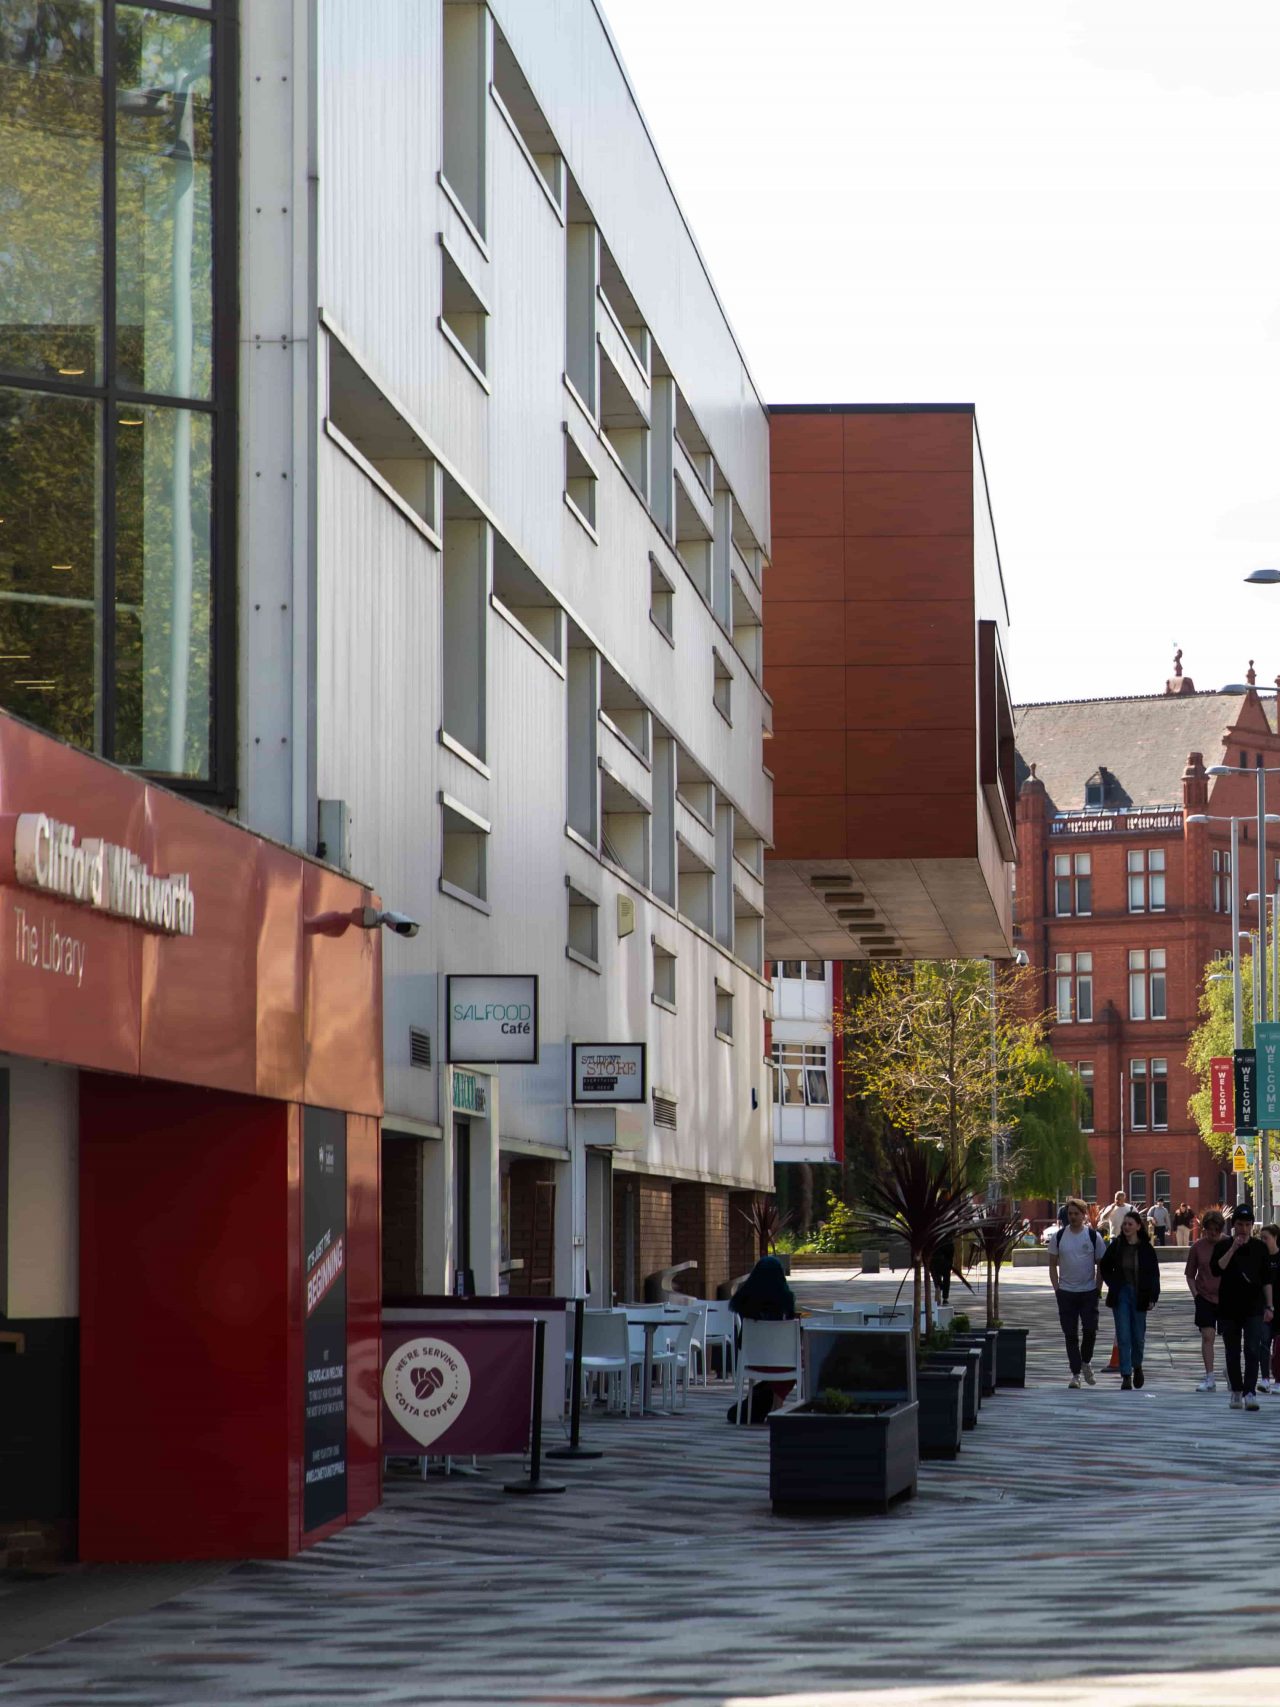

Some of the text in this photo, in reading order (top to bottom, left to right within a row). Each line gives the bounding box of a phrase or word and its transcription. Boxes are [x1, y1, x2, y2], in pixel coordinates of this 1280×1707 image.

[26, 812, 194, 936] Clifford Whitworth
[15, 906, 85, 988] The Library
[454, 1004, 531, 1020] SALFOOD
[501, 1022, 530, 1034] Café
[581, 1055, 621, 1065] STUDENT
[587, 1061, 636, 1075] STORE
[1218, 1072, 1227, 1118] WELCOME
[1241, 1067, 1251, 1122] WELCOME
[1265, 1045, 1277, 1113] WELCOME
[307, 1238, 343, 1312] BEGINNING
[395, 1347, 458, 1372] WE'RE SERVING
[395, 1392, 458, 1418] COSTA COFFEE
